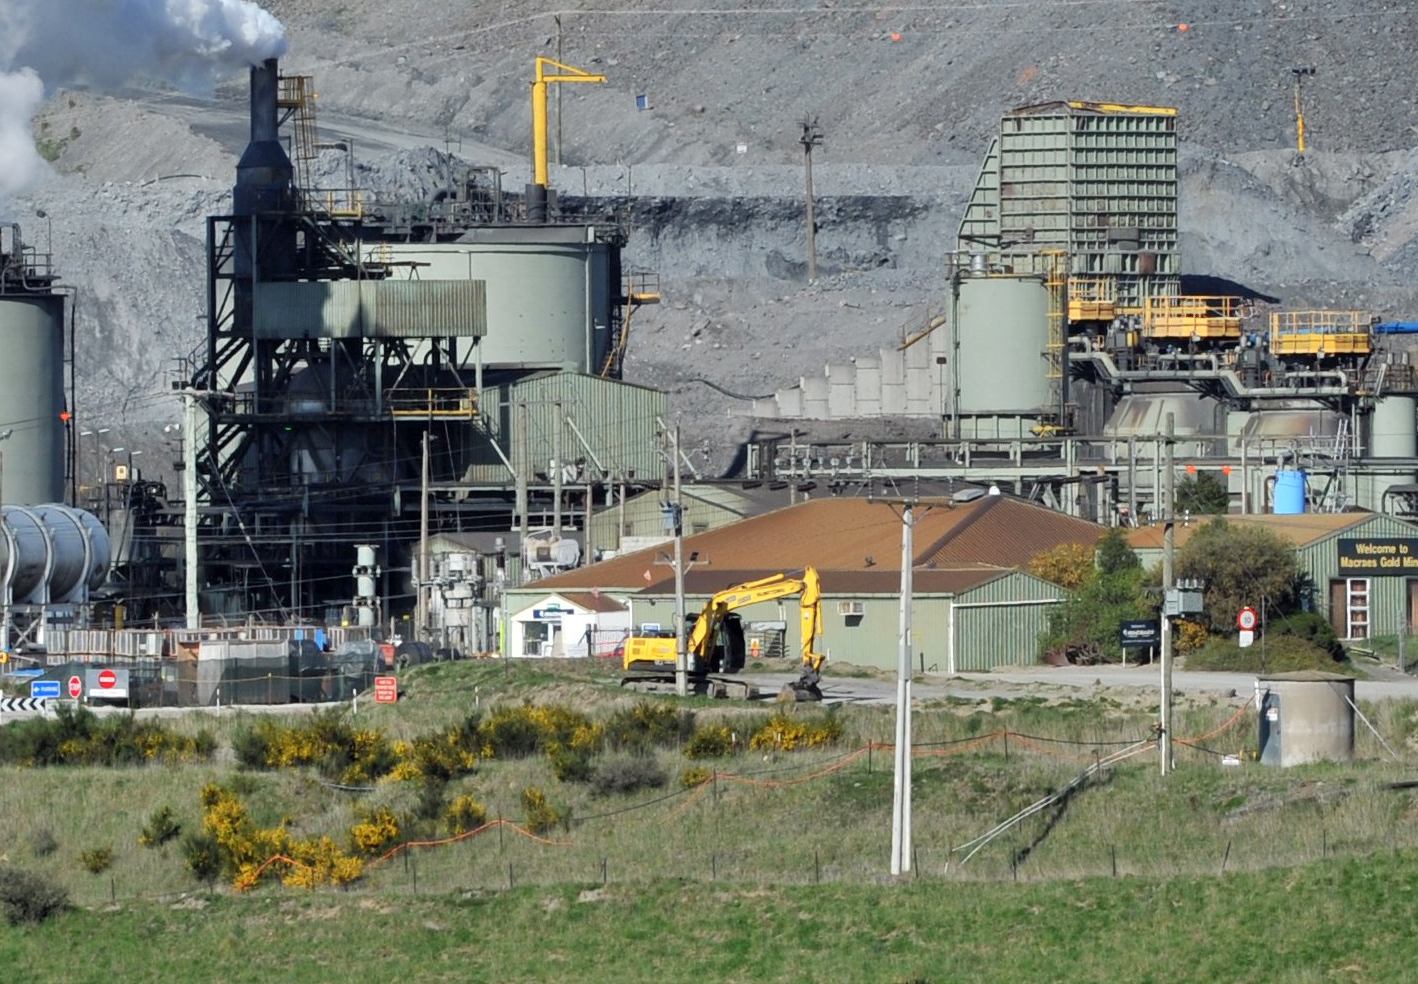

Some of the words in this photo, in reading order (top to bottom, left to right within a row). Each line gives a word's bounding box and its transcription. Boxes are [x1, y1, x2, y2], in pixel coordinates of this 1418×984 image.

[1356, 543, 1396, 554] Welcome
[1399, 543, 1409, 554] to
[1341, 556, 1377, 567] Macraes
[1380, 556, 1400, 567] Gold
